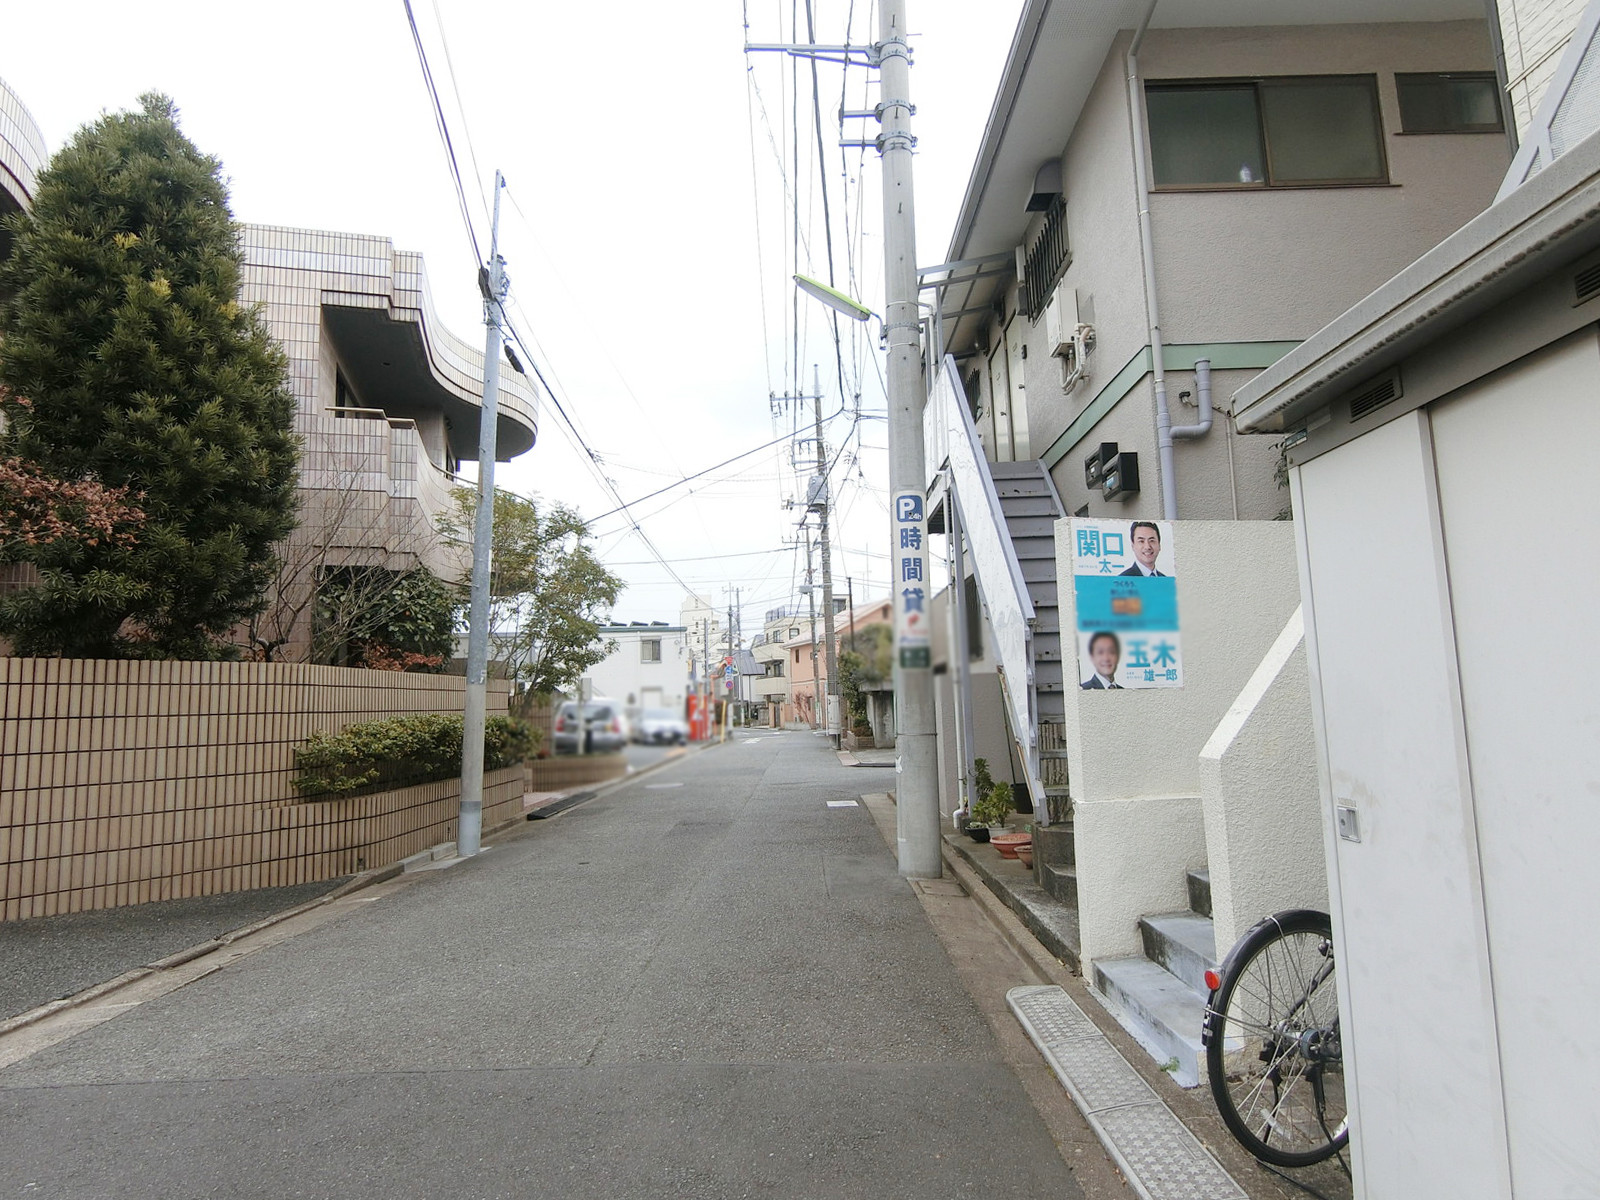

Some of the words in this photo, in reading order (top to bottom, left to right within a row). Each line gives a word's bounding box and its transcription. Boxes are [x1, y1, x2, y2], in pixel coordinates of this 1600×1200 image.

[1076, 529, 1124, 557] 関口
[1098, 558, 1125, 573] 太一
[1126, 639, 1176, 668] 玉木
